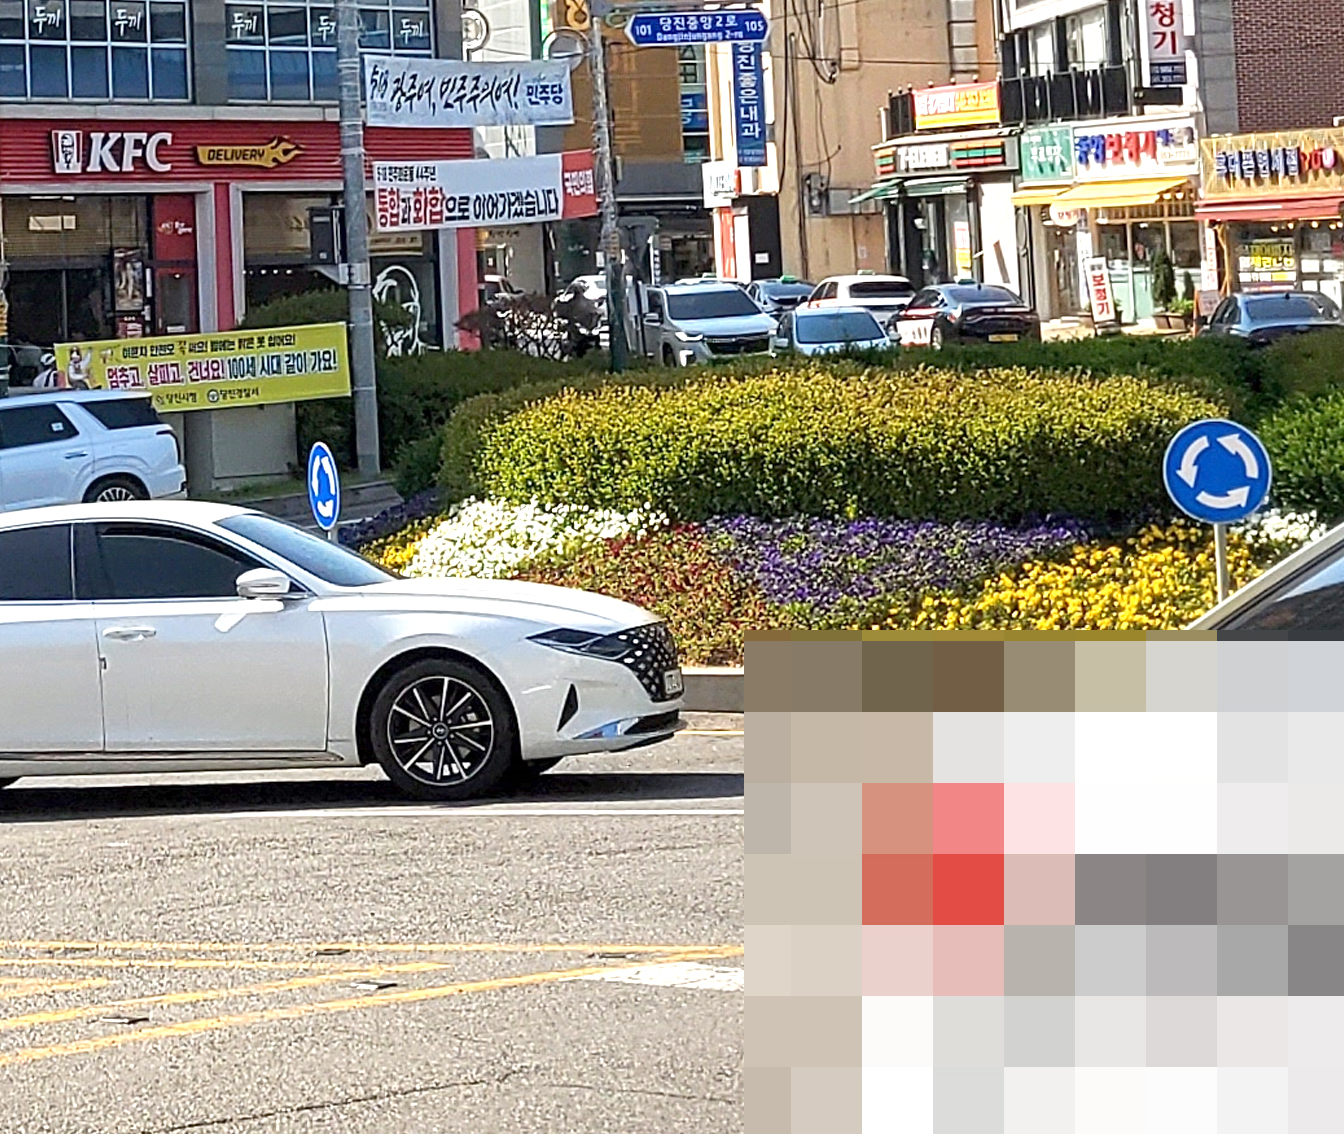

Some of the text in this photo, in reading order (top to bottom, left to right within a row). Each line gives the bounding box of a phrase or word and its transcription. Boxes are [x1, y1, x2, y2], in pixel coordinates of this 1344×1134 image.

[635, 15, 764, 36] 101 당진중앙2로 105
[525, 80, 564, 107] 민주당
[87, 130, 267, 173] KFC DELIVERY
[473, 187, 560, 222] 이어가겠습니다
[259, 354, 282, 379] 시대
[284, 352, 308, 375] 같이
